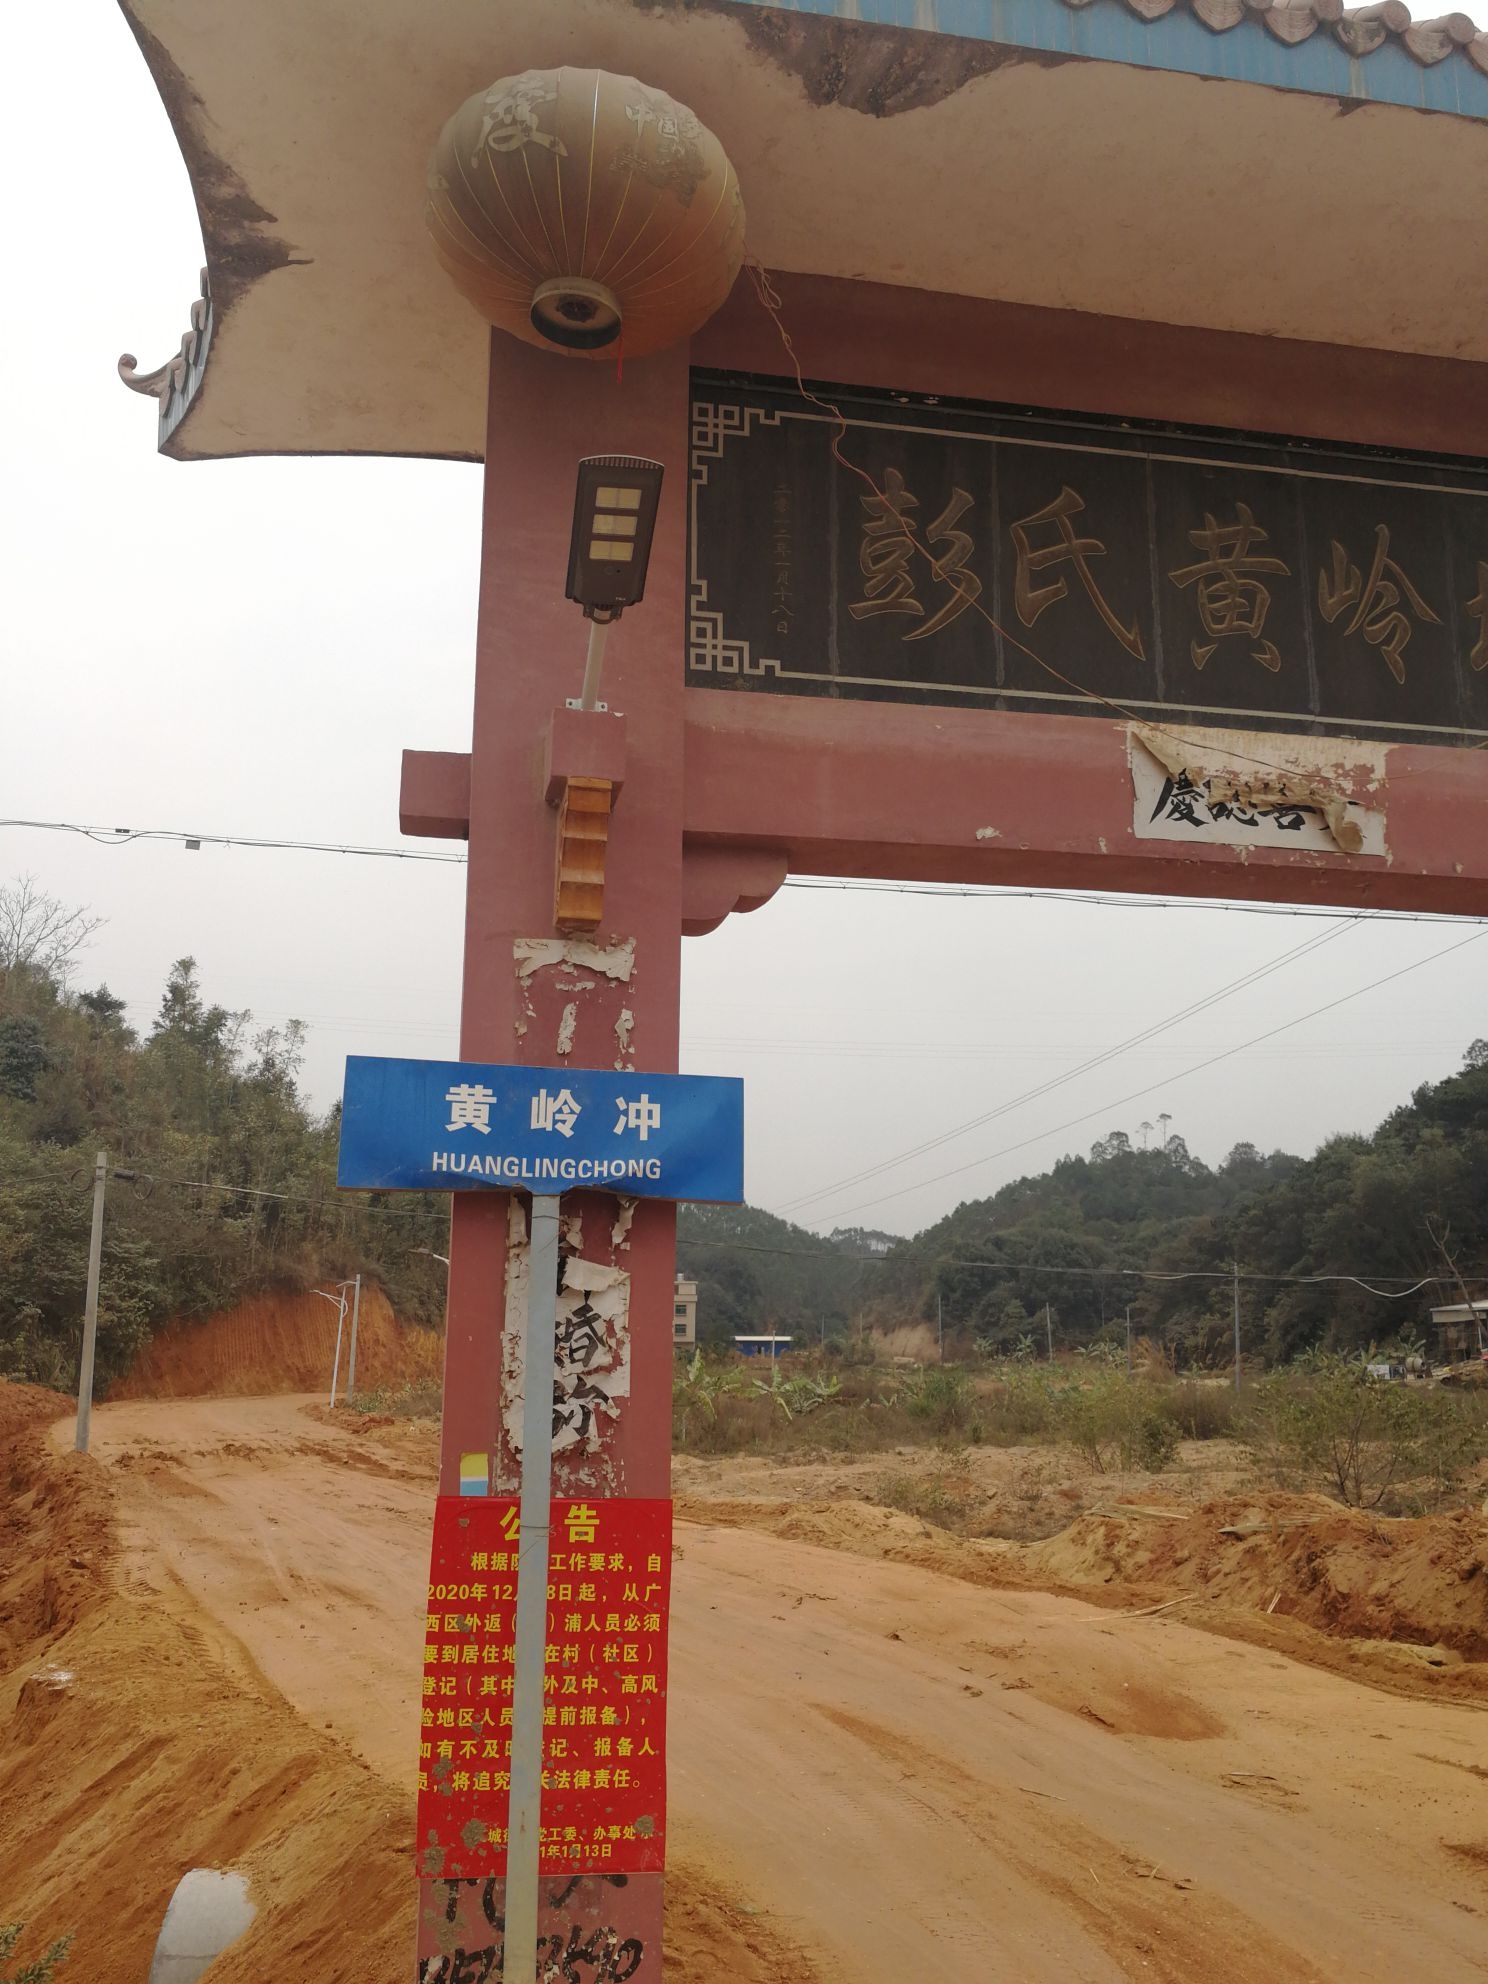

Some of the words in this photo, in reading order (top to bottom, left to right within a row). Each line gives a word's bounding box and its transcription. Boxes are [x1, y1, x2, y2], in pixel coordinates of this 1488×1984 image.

[848, 466, 1488, 685] 彭氏黄岭
[444, 1083, 661, 1141] 黄岭冲
[432, 1151, 661, 1180] HUANGLINGCHONG
[426, 1613, 661, 1633] 西区外返（）浦人员必须
[424, 1643, 653, 1664] 要到居住地在村（社区）
[422, 1674, 658, 1696] 登记（其中外及中、高风
[421, 1705, 648, 1727] 险地区人员提前报备），
